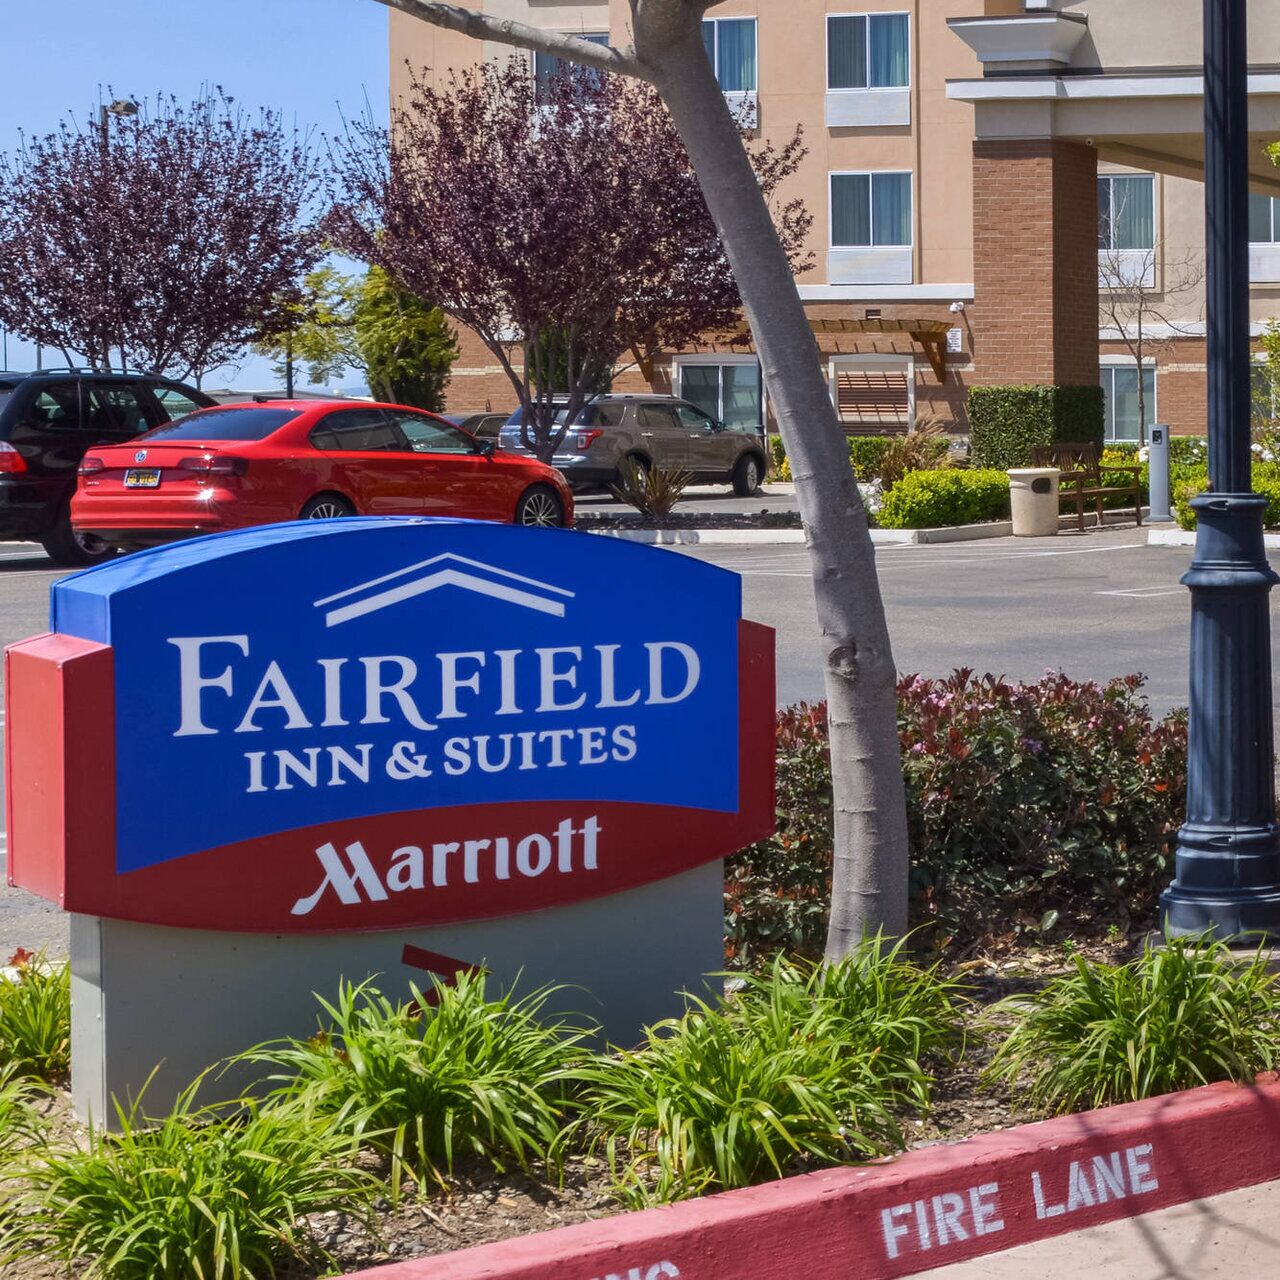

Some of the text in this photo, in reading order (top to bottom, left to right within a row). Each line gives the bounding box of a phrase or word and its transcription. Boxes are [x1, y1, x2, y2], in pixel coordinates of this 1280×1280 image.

[166, 633, 701, 738] FAIRFIELD
[244, 724, 638, 794] INN & SUITES
[290, 814, 602, 916] Marriott
[880, 1143, 1160, 1260] FIRE LANE
